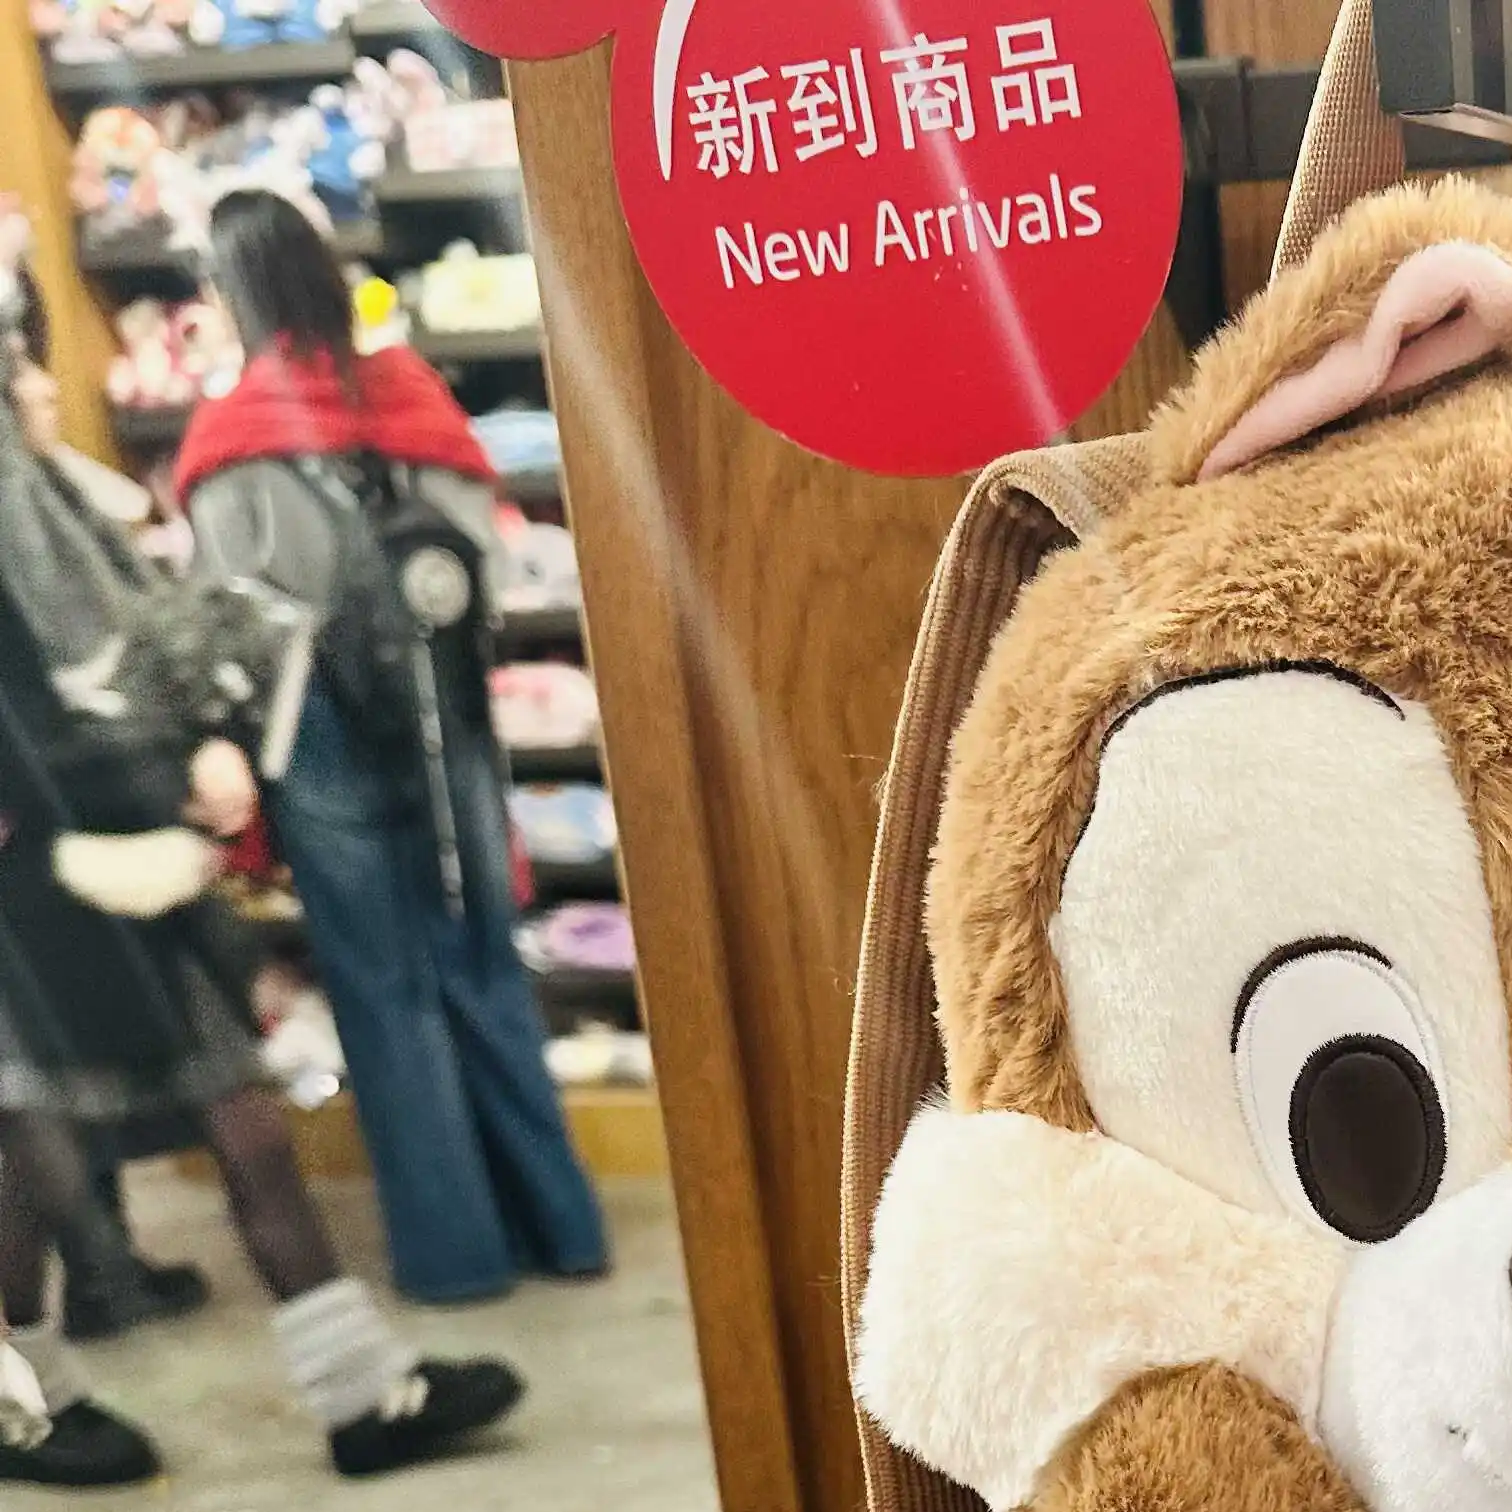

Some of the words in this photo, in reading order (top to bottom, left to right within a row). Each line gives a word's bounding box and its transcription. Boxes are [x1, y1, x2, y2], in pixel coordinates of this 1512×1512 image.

[686, 18, 1082, 180] 新到商品
[714, 222, 849, 289] New
[874, 173, 1102, 266] Arrivals
